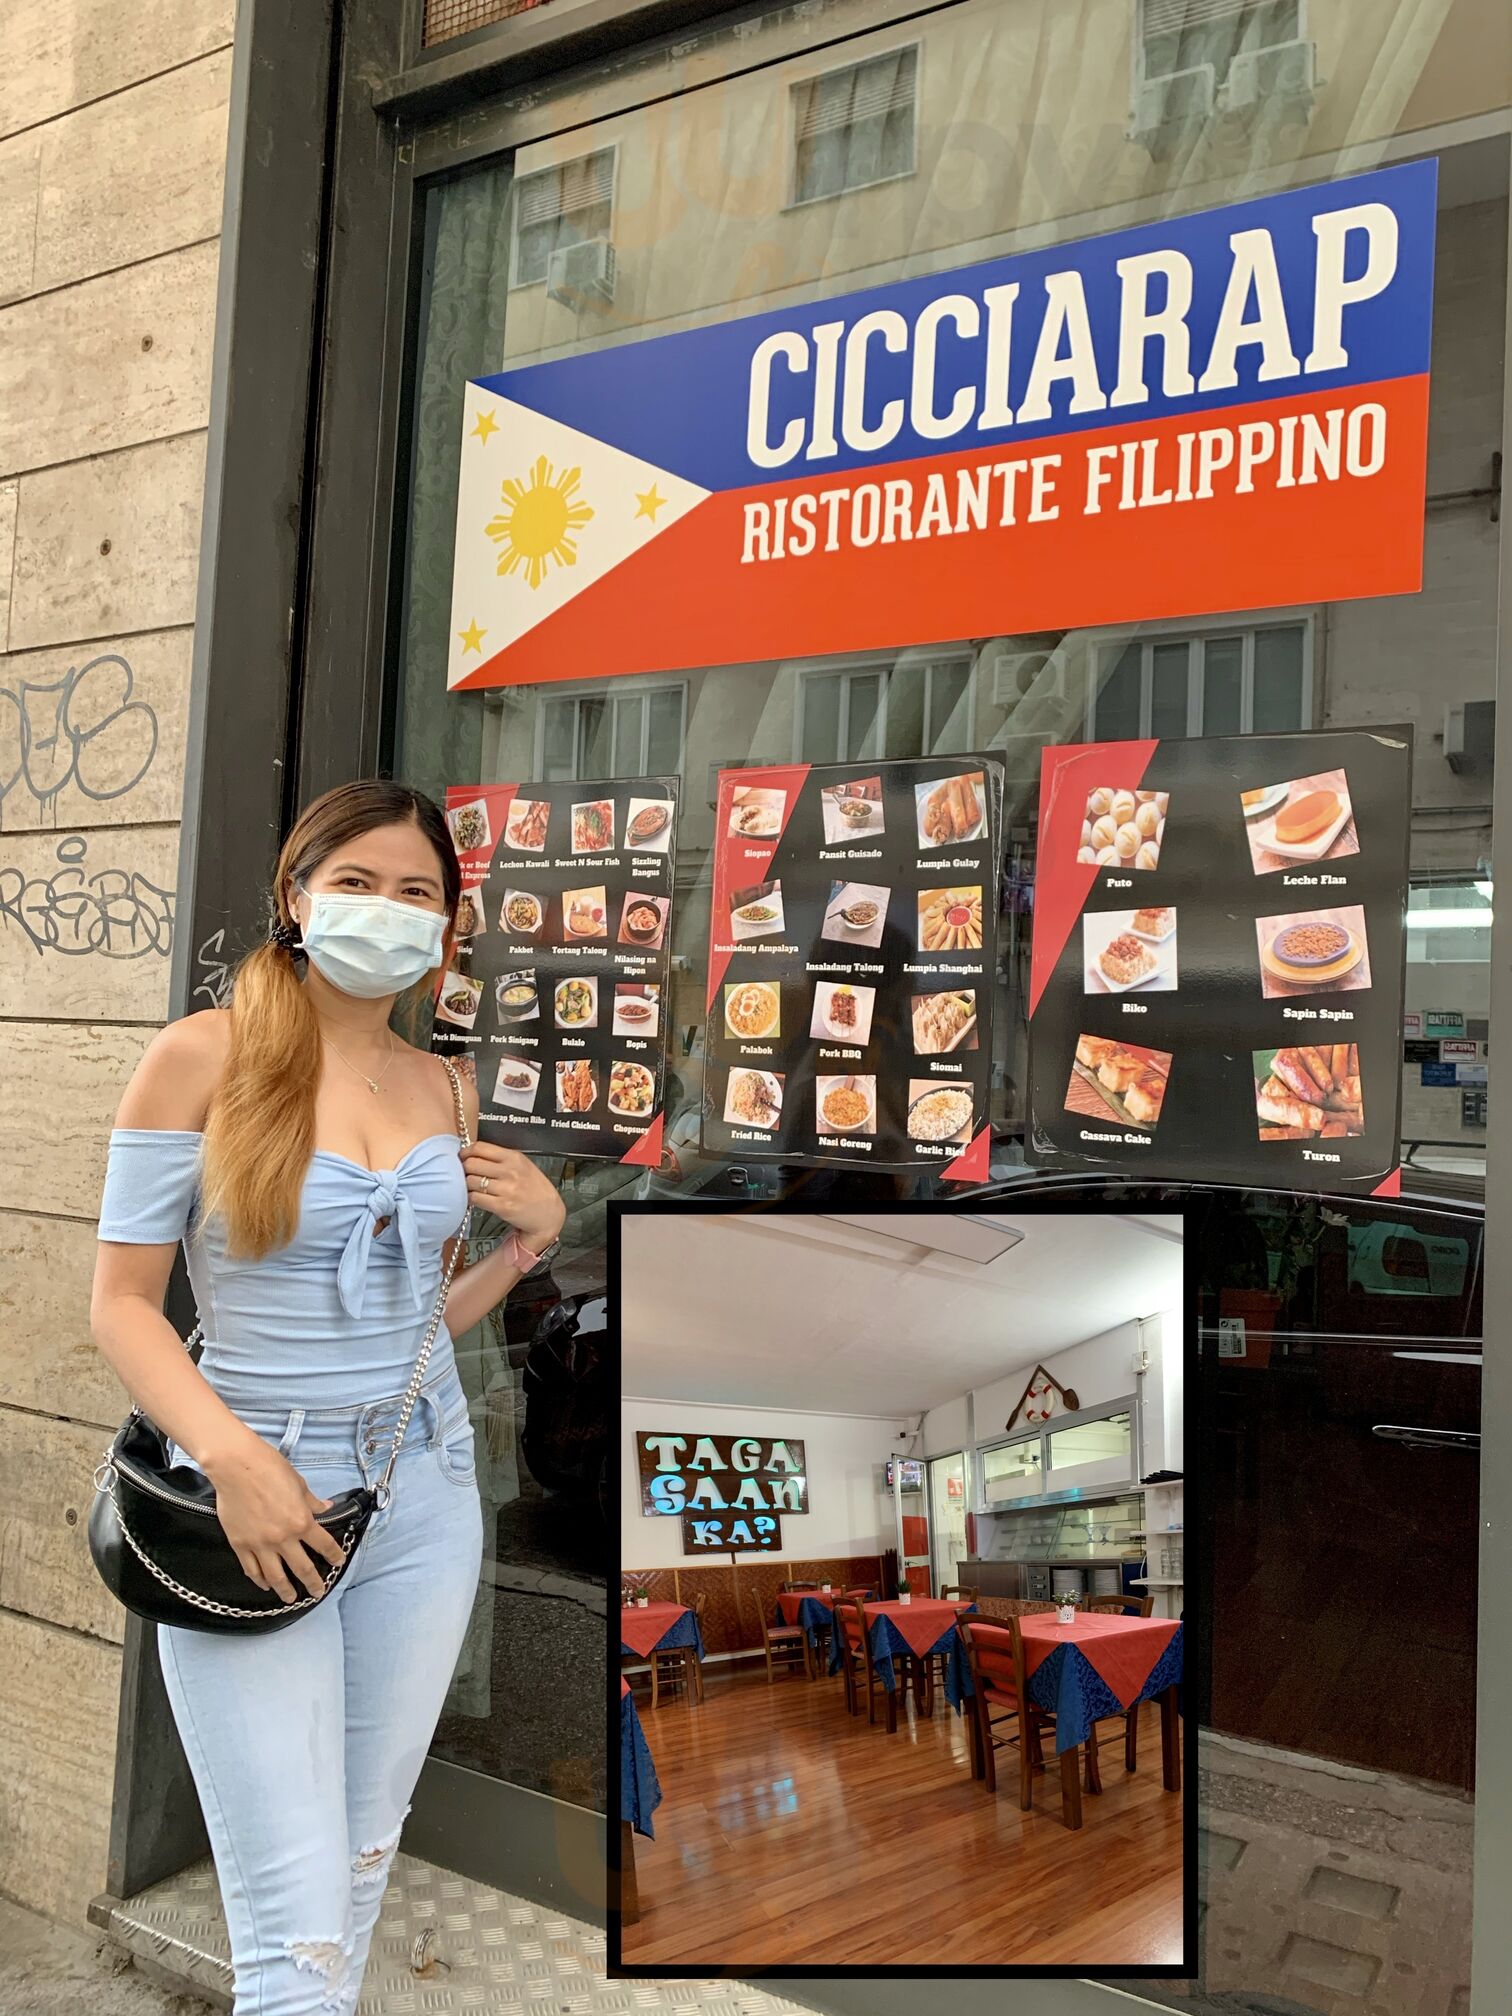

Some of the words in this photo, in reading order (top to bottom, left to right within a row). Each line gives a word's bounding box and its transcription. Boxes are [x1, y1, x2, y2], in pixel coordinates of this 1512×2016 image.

[744, 203, 1400, 470] CICCIARAP
[741, 455, 1063, 564] RISTORANTE
[1082, 403, 1387, 515] FILIPPINO
[744, 850, 771, 859] Siopao
[819, 851, 846, 859] Pansit
[848, 849, 882, 859] Guisado
[476, 860, 490, 869] Beef
[525, 860, 550, 868] Kawali
[555, 859, 576, 867] Sweet
[586, 858, 603, 866] Sour
[605, 858, 620, 866] Fish
[632, 858, 661, 867] Sizzling
[917, 860, 950, 869] Lumpia
[952, 859, 980, 869] Gulay
[465, 872, 491, 880] Express
[632, 869, 659, 877] Bangus
[1107, 878, 1132, 887] Puto
[1283, 875, 1317, 886] Leche
[1320, 875, 1346, 885] Flan
[457, 946, 473, 955] Sisig
[509, 946, 533, 954] Pakbet
[552, 946, 580, 956] Tortang
[582, 947, 607, 956] Talong
[714, 944, 757, 953] Insaladang
[758, 944, 799, 953] Ampalaya
[614, 955, 645, 964] Nilasing
[647, 956, 656, 964] na
[623, 967, 646, 975] Hipon
[806, 963, 852, 973] Insaladang
[854, 963, 884, 973] Talong
[903, 964, 937, 973] Lumpia
[939, 964, 983, 974] Shanghai
[1122, 1004, 1147, 1013] Biko
[1283, 1008, 1317, 1021] Sapin
[1319, 1009, 1353, 1022] Sapin
[432, 1033, 448, 1041] Pork
[450, 1034, 482, 1043] Dinuguan
[508, 1036, 538, 1046] Sinigang
[562, 1038, 585, 1046] Bulalo
[626, 1040, 647, 1049] Bopis
[740, 1046, 773, 1055] Palabok
[820, 1049, 840, 1058] Pork
[842, 1050, 862, 1059] BBQ
[930, 1062, 962, 1072] Siomai
[509, 1114, 529, 1125] Spare
[530, 1116, 546, 1124] Ribs
[551, 1120, 570, 1128] Fried
[571, 1121, 600, 1130] Chicken
[613, 1124, 649, 1135] Chopsuey
[731, 1131, 752, 1140] Fried
[754, 1132, 771, 1141] Rice
[1080, 1131, 1123, 1144] Cassava
[1125, 1134, 1151, 1144] Cake
[819, 1137, 839, 1147] Nasi
[840, 1138, 872, 1150] Goreng
[916, 1145, 943, 1155] Garlic
[945, 1147, 965, 1157] Rice
[1302, 1151, 1340, 1162] Turon
[645, 1437, 800, 1473] TAGA
[691, 1516, 776, 1546] KA?
